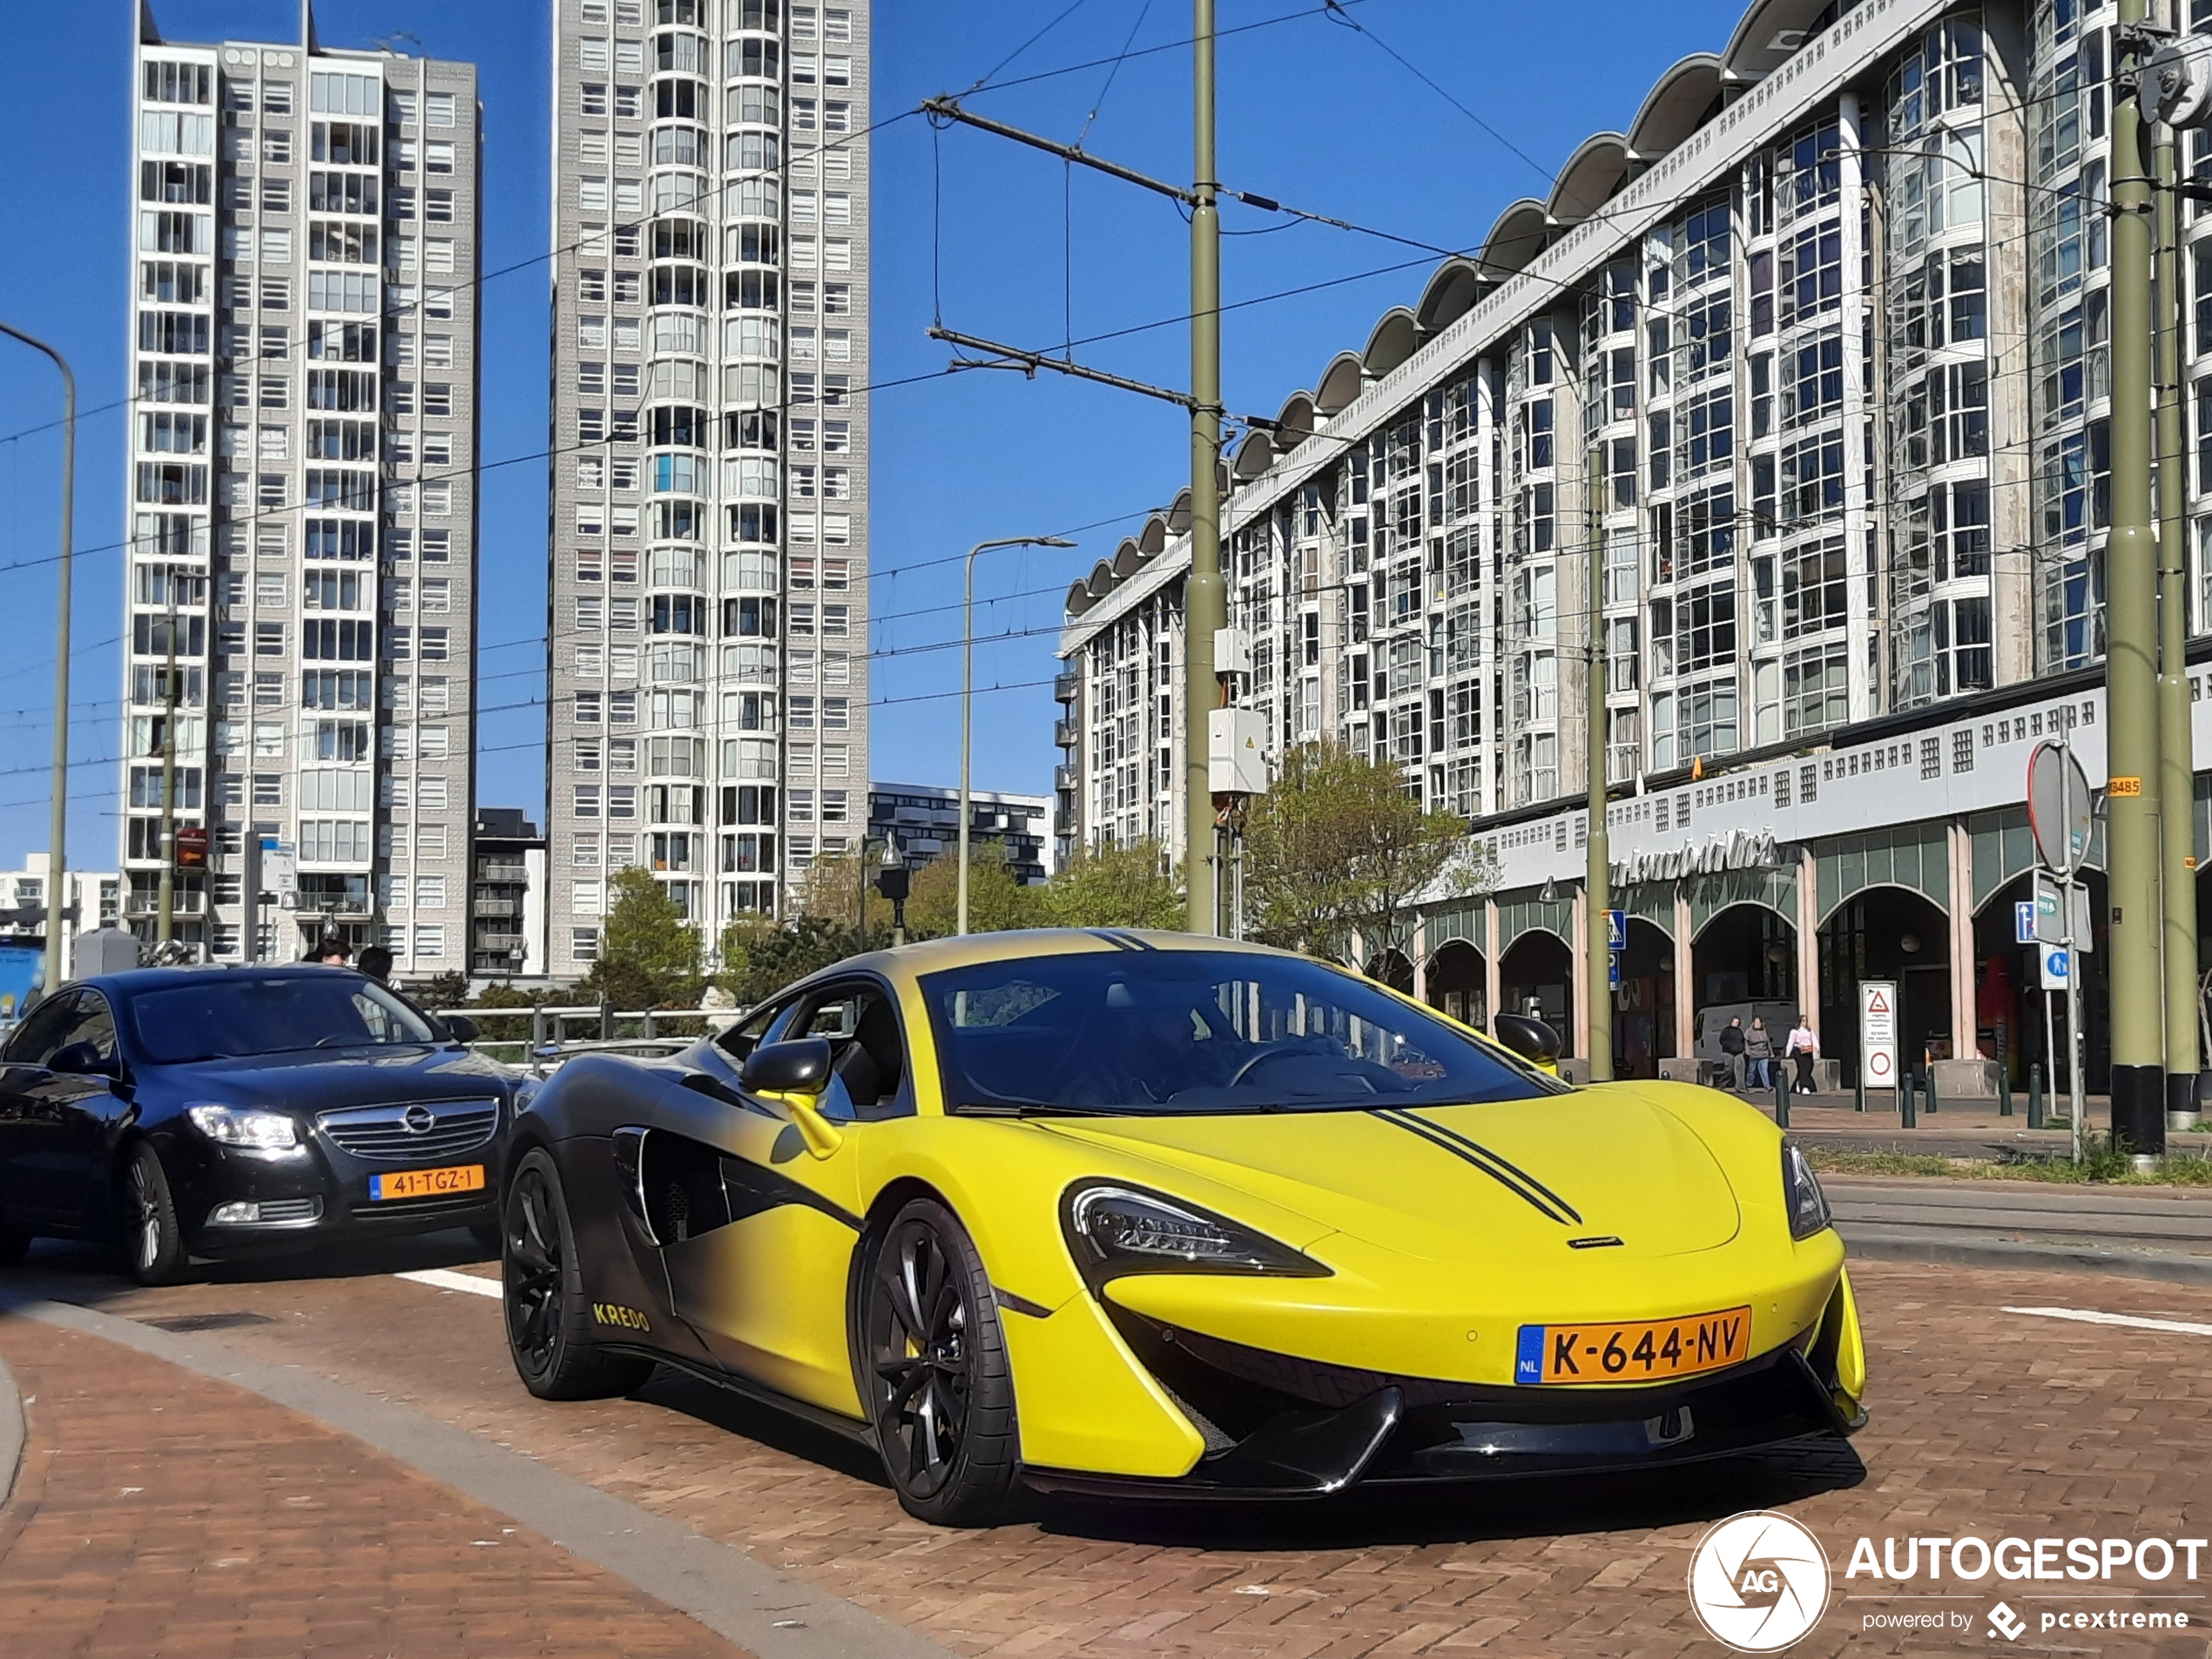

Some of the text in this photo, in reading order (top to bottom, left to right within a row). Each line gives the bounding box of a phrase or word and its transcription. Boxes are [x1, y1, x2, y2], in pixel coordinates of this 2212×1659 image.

[394, 1169, 472, 1193] 41-TGZ-1
[592, 1302, 651, 1332] KREDO
[1553, 1316, 1741, 1375] K-644-NV
[1520, 1360, 1539, 1373] NL
